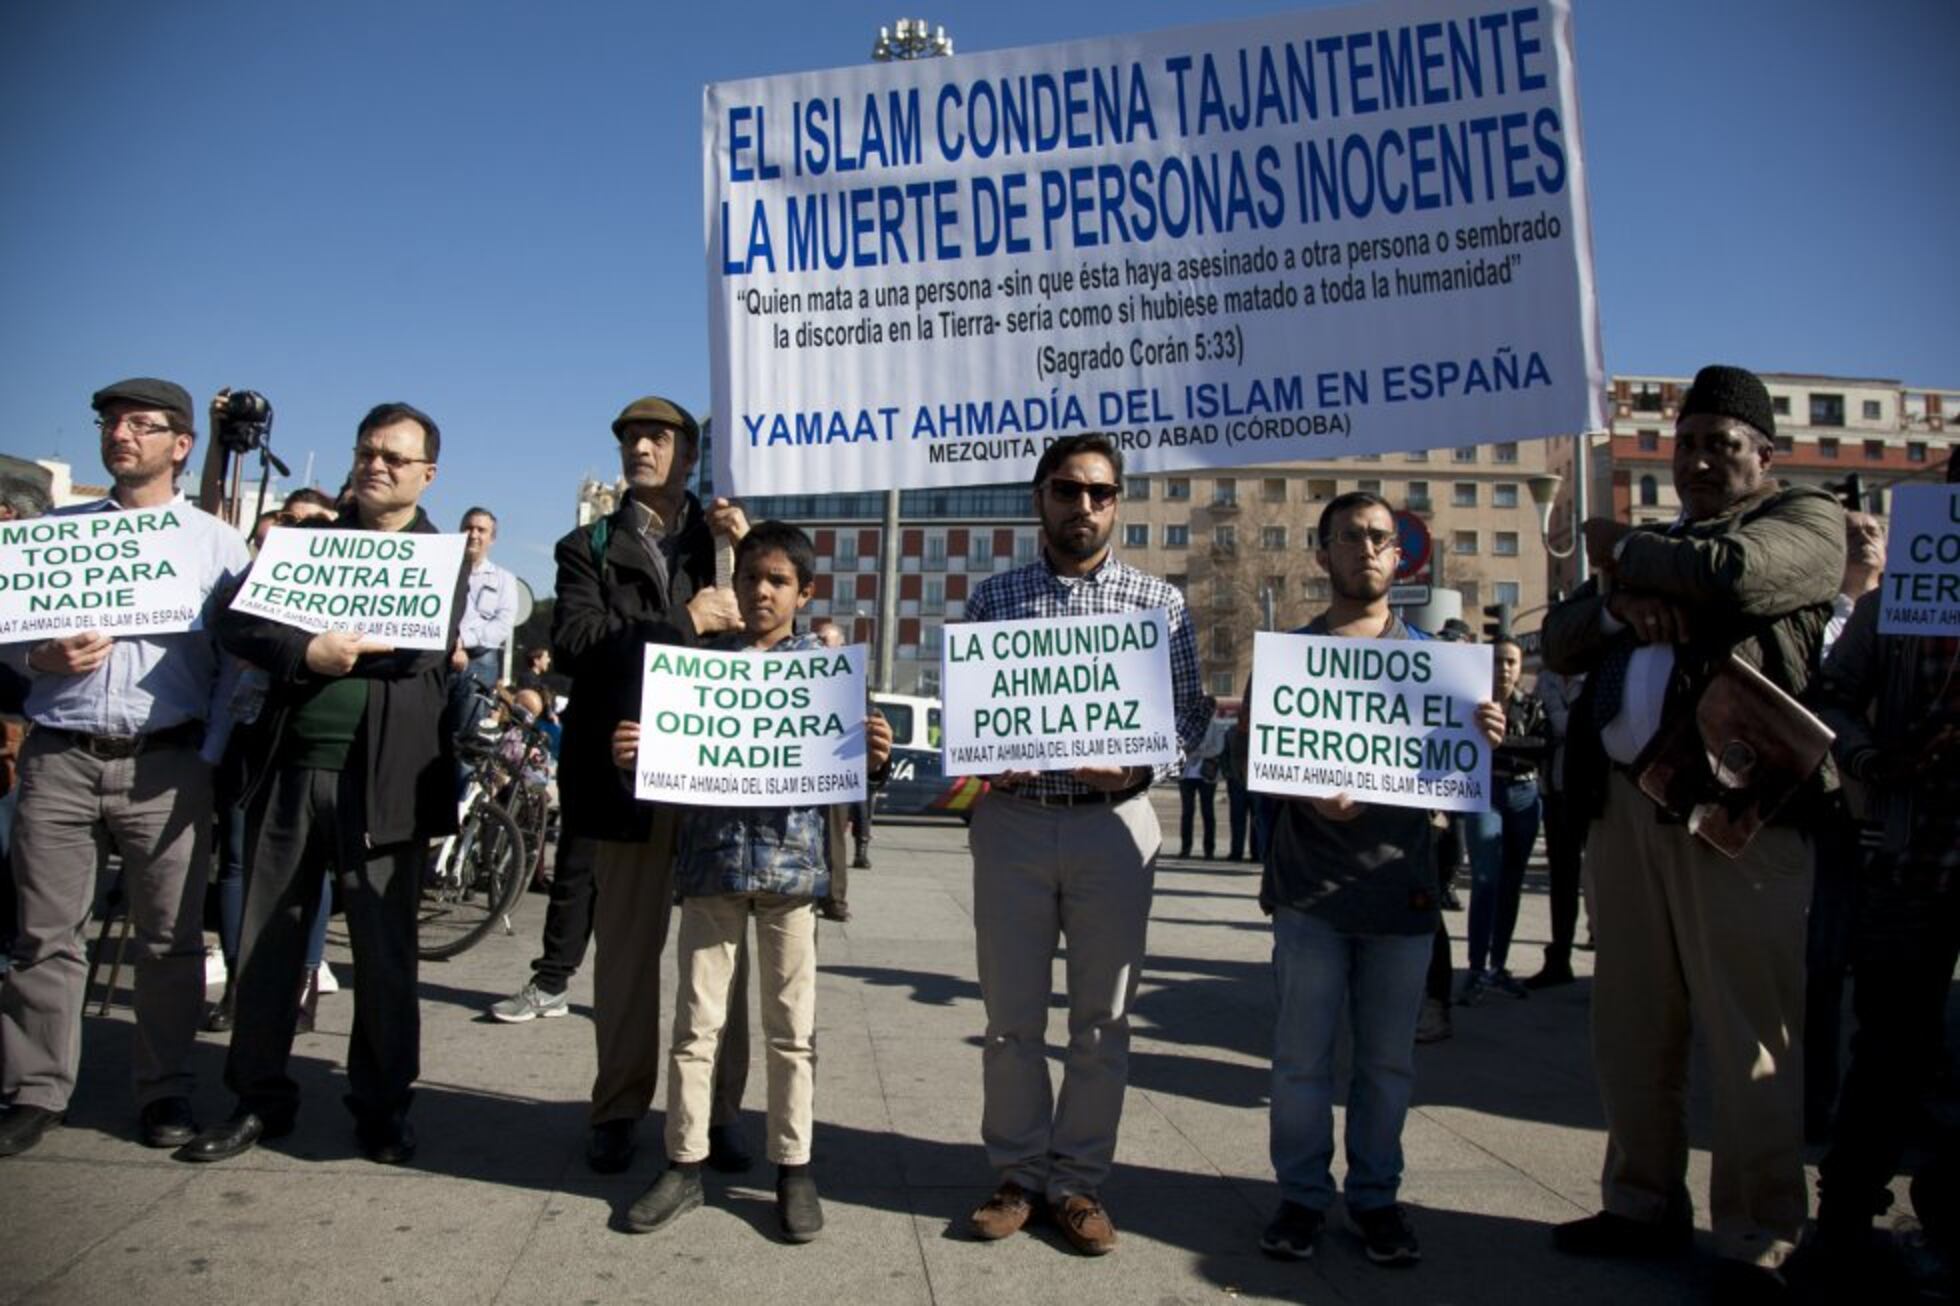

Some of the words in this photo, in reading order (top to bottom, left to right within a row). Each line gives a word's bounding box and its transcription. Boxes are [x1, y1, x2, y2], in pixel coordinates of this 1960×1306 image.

[729, 106, 780, 182] EL
[793, 88, 923, 176] ISLAM
[937, 62, 1157, 162] CONDENA
[1166, 7, 1546, 136] TAJANTEMENTE
[722, 199, 776, 275] LA
[788, 180, 960, 272] MUERTE
[972, 173, 1030, 257] DE
[1040, 145, 1284, 250] PERSONAS
[1296, 107, 1567, 224] INOCENTES
[808, 287, 853, 313] mata
[859, 290, 869, 308] a
[875, 286, 909, 307] una
[916, 278, 991, 310] persona
[998, 271, 1032, 304] -sin
[1039, 272, 1073, 300] que
[1080, 263, 1120, 290] ésta
[1126, 260, 1171, 290] haya
[1177, 247, 1278, 284] asesinado
[1285, 251, 1294, 270] a
[1301, 241, 1341, 268] otra
[1348, 234, 1430, 272] persona
[1437, 232, 1448, 252] o
[1457, 212, 1561, 250] sembrado
[774, 323, 788, 349] la
[795, 316, 883, 347] discordia
[889, 320, 911, 342] en
[917, 314, 933, 340] la
[939, 310, 1000, 338] Tierra-
[1007, 302, 1052, 334] sería
[1059, 303, 1112, 328] como
[1119, 297, 1135, 322] si
[1142, 291, 1218, 321] hubiese
[1224, 284, 1297, 315] matado
[1305, 285, 1315, 305] a
[1321, 274, 1365, 302] toda
[1372, 271, 1389, 297] la
[1037, 344, 1123, 381] (Sagrado
[1130, 331, 1189, 367] Corán
[1195, 325, 1243, 366] 5:33)
[743, 408, 899, 447] YAMAAT
[912, 388, 1086, 439] AHMADÍA
[1100, 388, 1174, 426] DEL
[1186, 375, 1303, 419] ISLAM
[1318, 370, 1368, 408] EN
[1384, 346, 1552, 402] ESPAÑA
[930, 439, 1035, 463] MEZQUITA
[1110, 429, 1151, 450] DRO
[1158, 428, 1218, 447] ABAD
[1225, 413, 1351, 447] (CÓRDOBA)
[2, 522, 79, 545] MOR
[92, 511, 180, 538] PARA
[22, 540, 140, 567] TODOS
[309, 536, 415, 560] UNIDOS
[1910, 533, 1960, 564] CO
[85, 560, 176, 586] PARA
[272, 562, 389, 588] CONTRA
[400, 567, 432, 588] EL
[1890, 573, 1960, 602] TER
[30, 588, 135, 612] NADIE
[250, 582, 441, 618] TERRORISMO
[21, 614, 72, 632] AHMADÍA
[75, 614, 96, 629] DEL
[100, 613, 133, 628] ISLAM
[135, 611, 149, 625] EN
[152, 606, 194, 624] ESPAÑA
[385, 622, 398, 636] EN
[401, 621, 440, 639] ESPAÑA
[950, 634, 984, 662] LA
[993, 621, 1158, 660] COMUNIDAD
[651, 653, 750, 681] AMOR
[763, 654, 852, 681] PARA
[992, 656, 1119, 697] AHMADÍA
[1306, 645, 1431, 683] UNIDOS
[694, 686, 810, 709] TODOS
[1273, 685, 1411, 725] CONTRA
[1423, 695, 1463, 728] EL
[656, 711, 741, 738] ODIO
[753, 713, 844, 738] PARA
[975, 706, 1032, 738] POR
[1042, 704, 1077, 734] LA
[1086, 701, 1141, 731] PAZ
[699, 745, 802, 768] NADIE
[951, 745, 994, 764] YAMAAT
[997, 738, 1045, 760] AHMADÍA
[1049, 741, 1069, 758] DEL
[1072, 739, 1104, 757] ISLAM
[1108, 738, 1122, 755] EN
[1126, 732, 1168, 753] ESPAÑA
[1256, 724, 1479, 773] TERRORISMO
[642, 772, 686, 790] YAMAAT
[690, 773, 738, 794] AHMADÍA
[742, 778, 762, 794] DEL
[766, 777, 798, 794] ISLAM
[801, 777, 815, 793] EN
[818, 770, 859, 791] ESPAÑA
[1253, 762, 1300, 781] YAMAAT
[1303, 766, 1353, 787] AHMADÍA
[1357, 772, 1378, 791] DEL
[1381, 773, 1414, 793] ISLAM
[1418, 777, 1434, 796] EN
[1436, 777, 1482, 799] ESPAÑA
